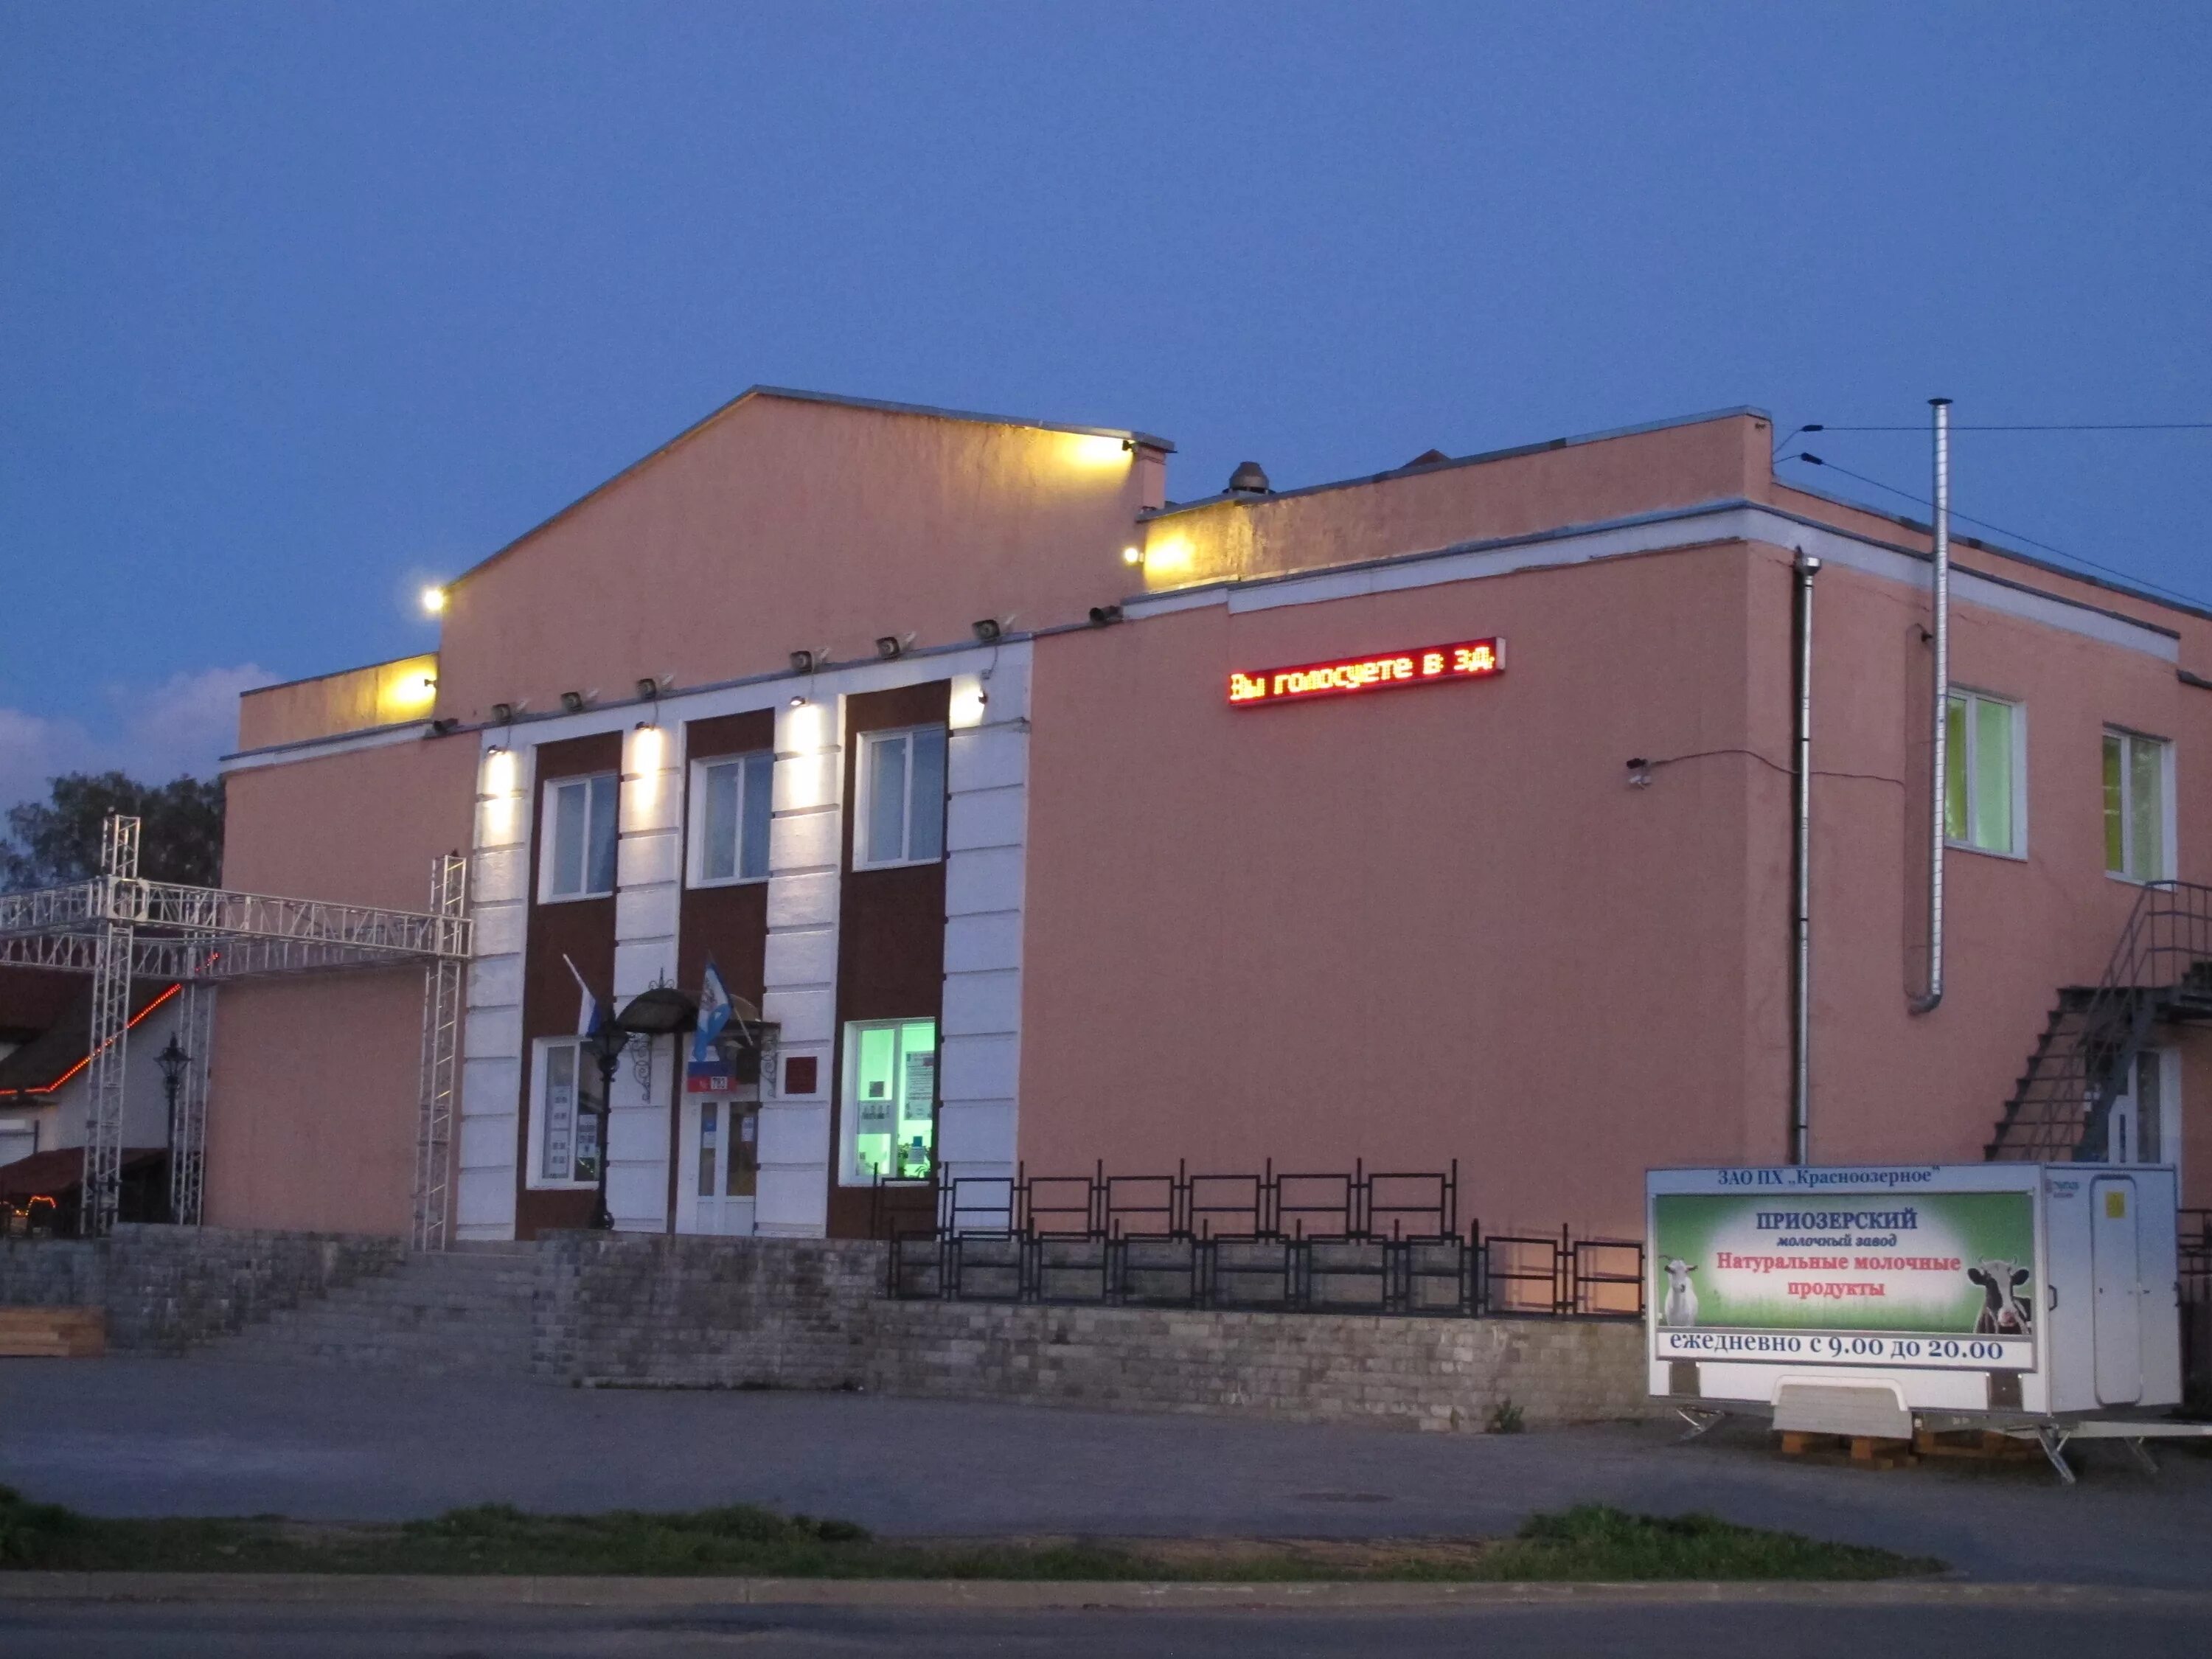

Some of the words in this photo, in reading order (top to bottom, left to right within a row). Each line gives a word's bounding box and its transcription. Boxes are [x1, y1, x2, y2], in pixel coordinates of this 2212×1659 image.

[1273, 658, 1413, 695] голосуете
[1718, 1169, 1753, 1186] ЗАО
[1757, 1169, 1784, 1185] ПХ
[1756, 1208, 1918, 1230] ПРИОЗЕРСКИЙ
[1776, 1234, 1852, 1247] молочный
[1855, 1234, 1897, 1248] завод
[1717, 1252, 1849, 1273] Натуральные
[1854, 1256, 1962, 1271] молочные
[1787, 1281, 1885, 1299] продукты
[1669, 1334, 1801, 1353] ежедневно
[1810, 1338, 1822, 1353] с
[1829, 1337, 1884, 1357] 9.00
[1891, 1342, 1921, 1359] до
[1927, 1340, 2004, 1360] 20.00
